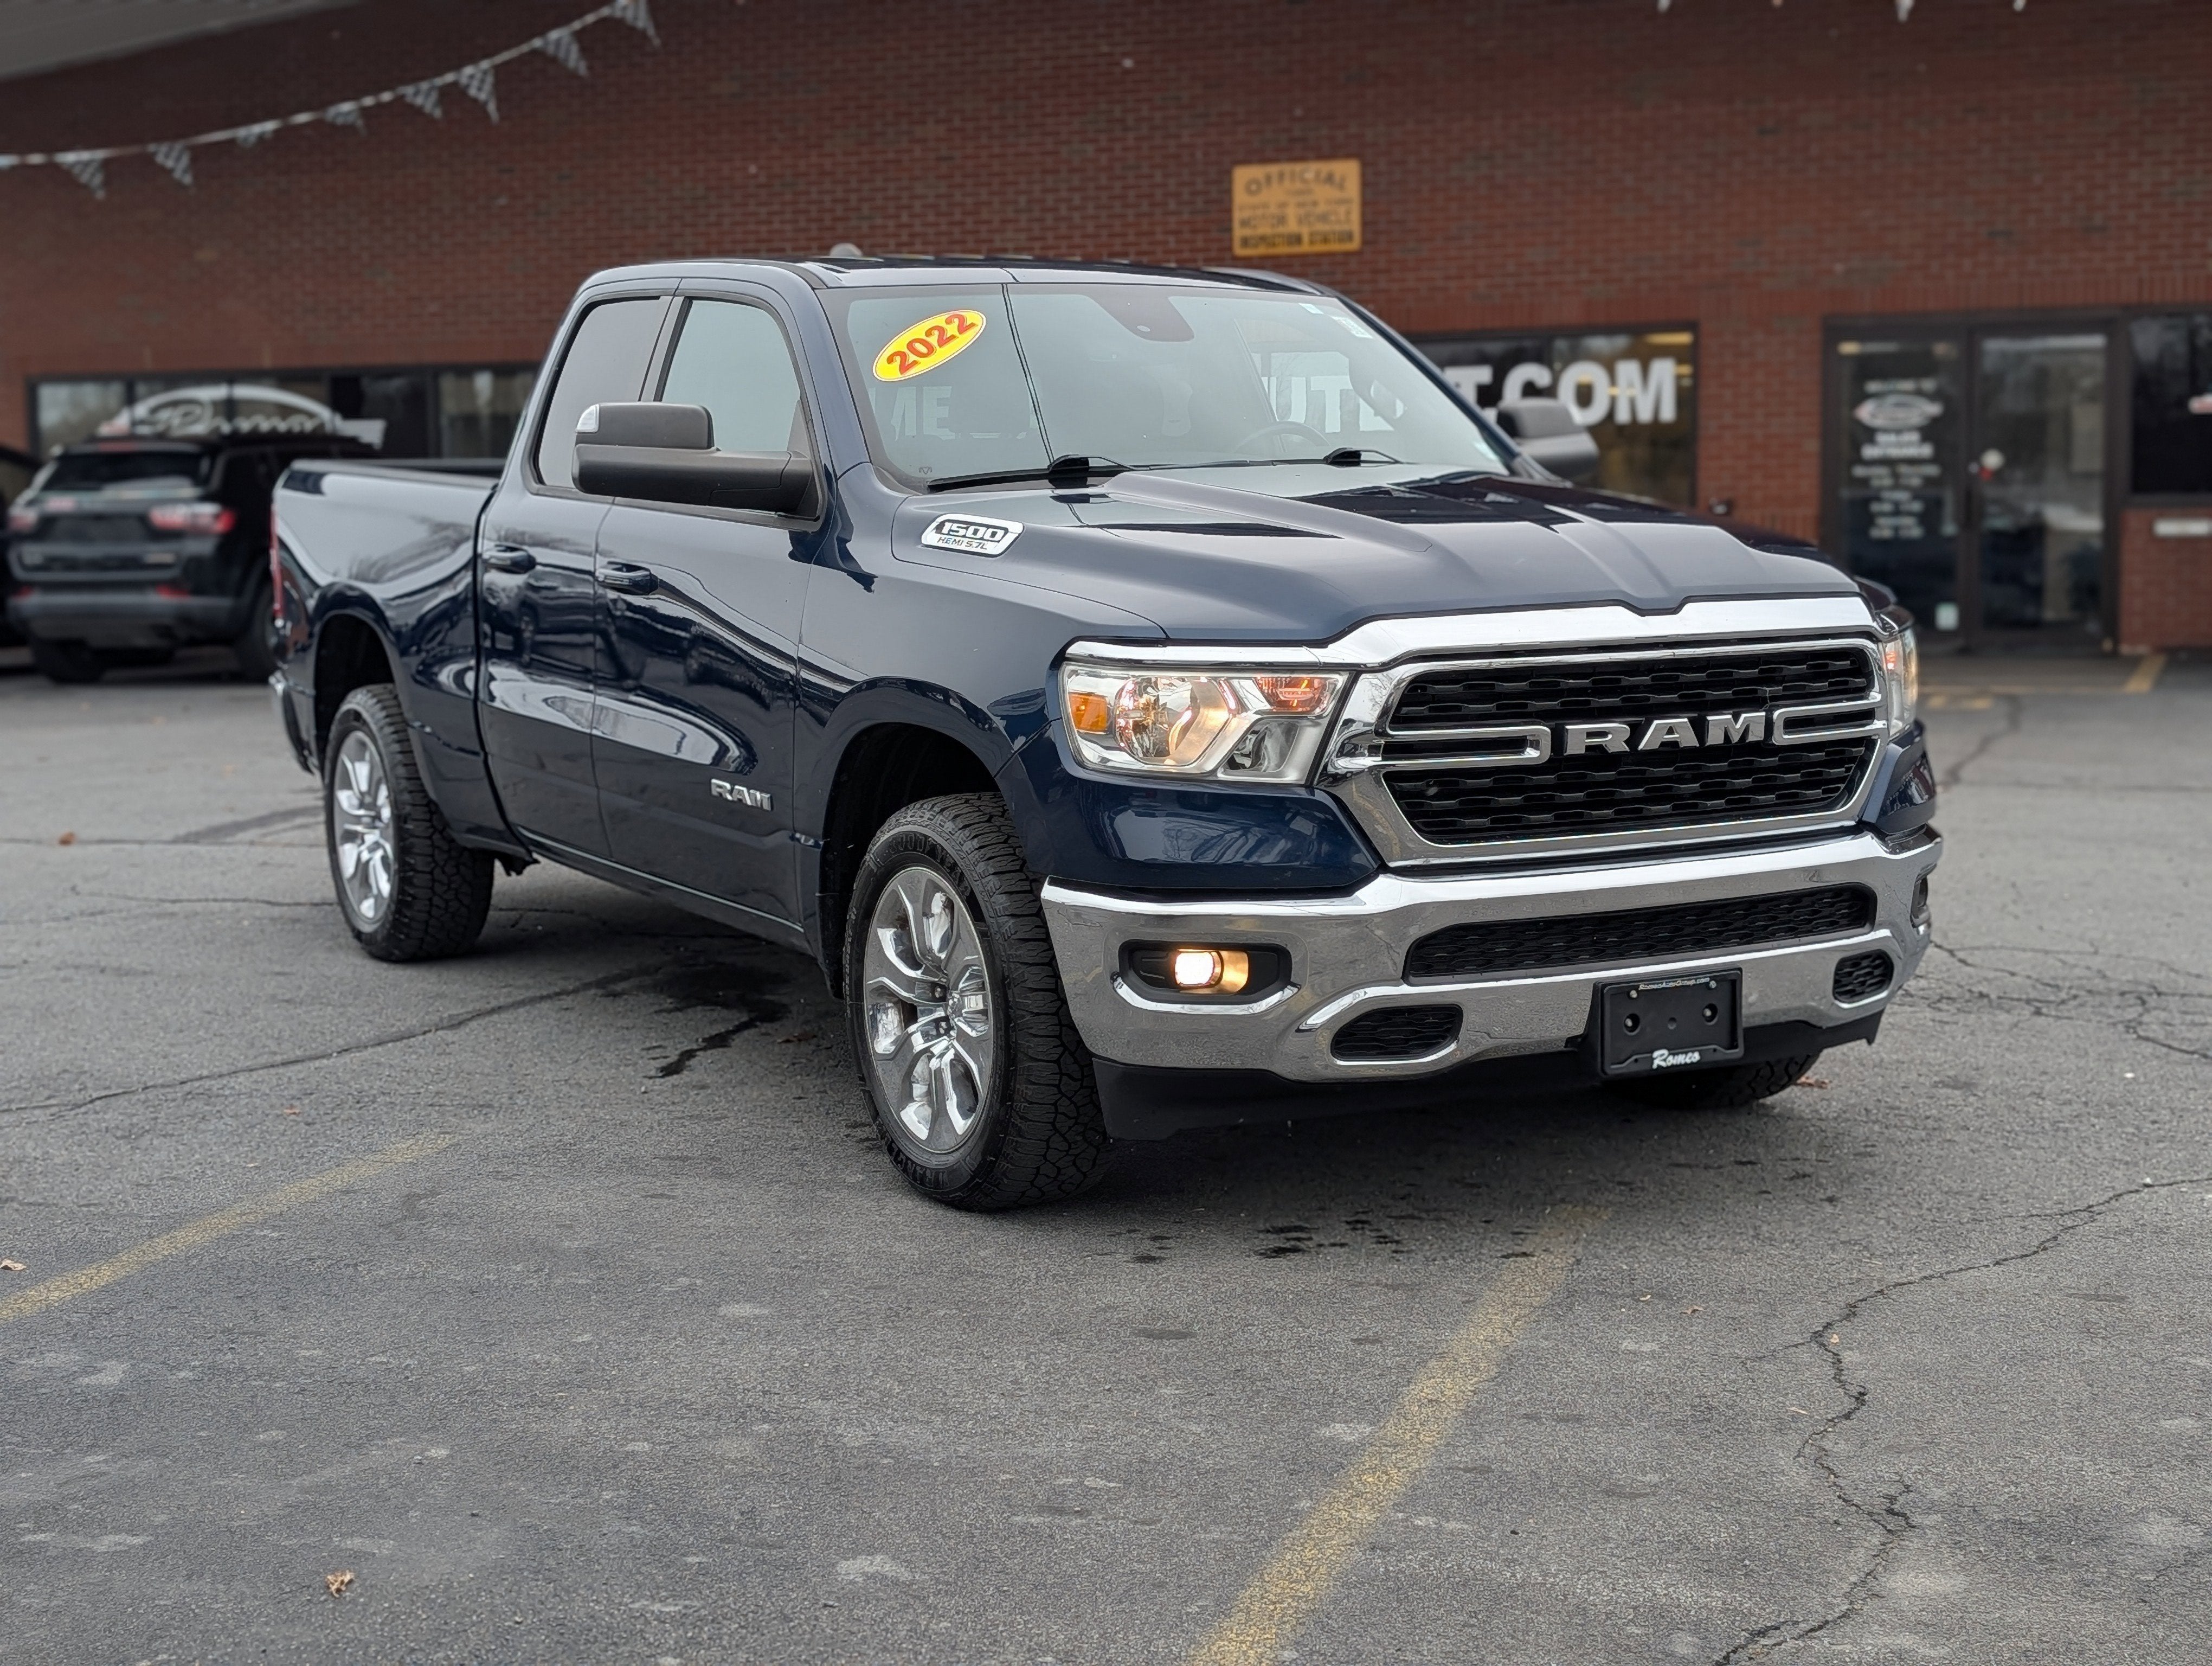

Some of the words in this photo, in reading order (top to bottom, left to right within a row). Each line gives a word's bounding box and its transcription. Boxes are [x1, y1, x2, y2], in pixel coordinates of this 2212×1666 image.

[1244, 167, 1345, 197] OFFICIAL
[886, 313, 979, 375] 2022
[937, 536, 963, 546] HEMI
[964, 540, 987, 550] 5.7L
[941, 522, 1005, 542] 1500
[1564, 712, 1766, 756] RAM
[711, 778, 774, 811] RAM
